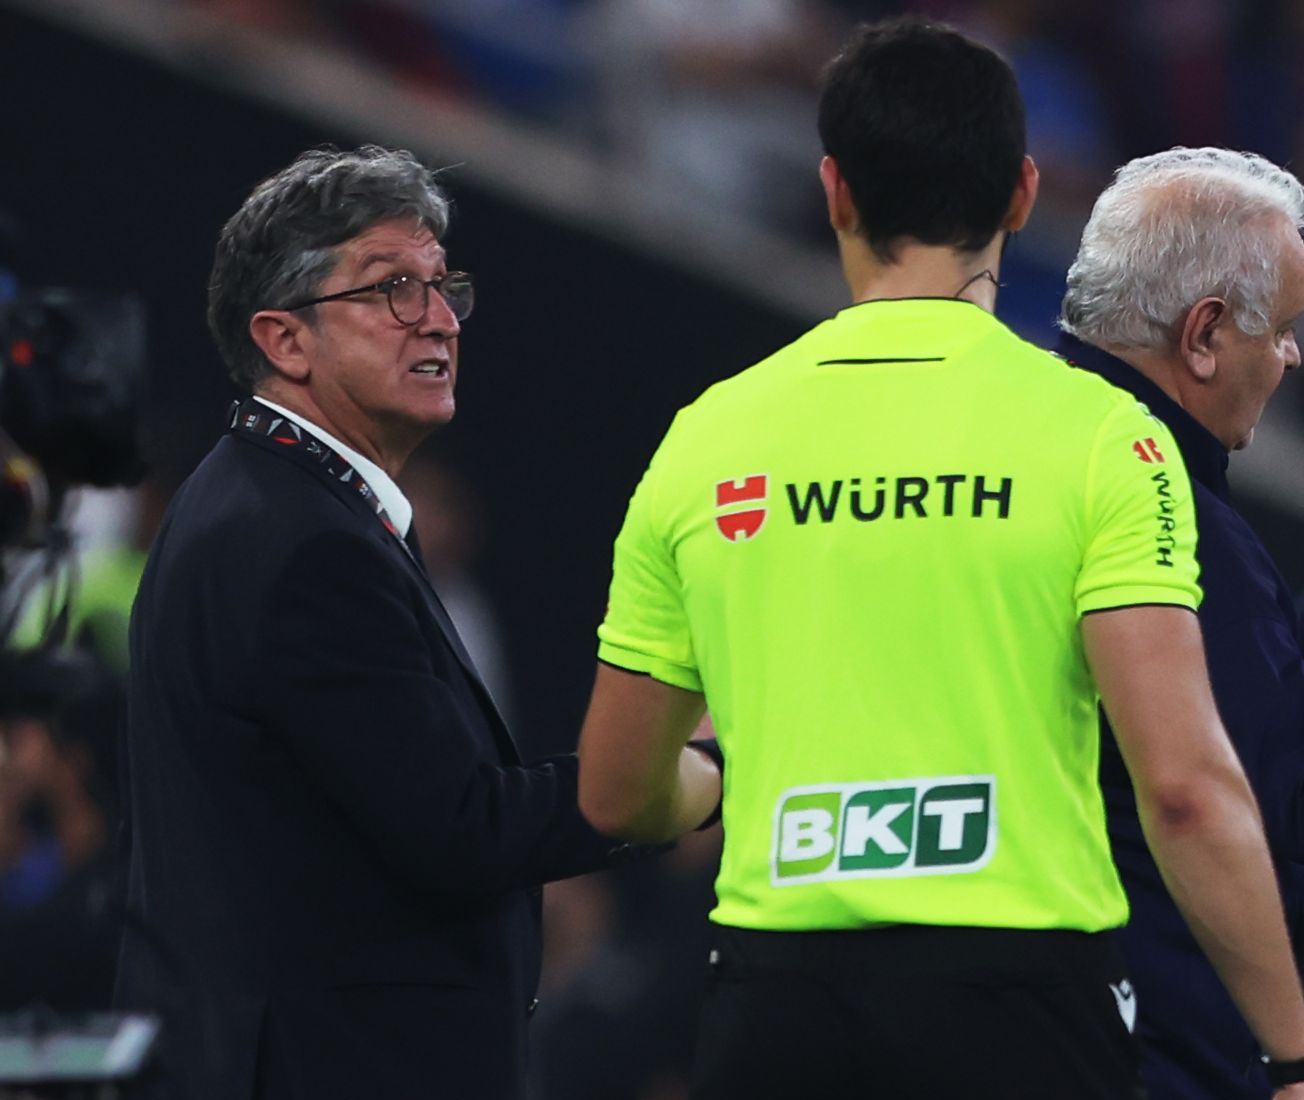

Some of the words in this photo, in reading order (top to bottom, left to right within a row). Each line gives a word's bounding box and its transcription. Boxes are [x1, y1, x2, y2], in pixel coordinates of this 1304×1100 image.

[785, 474, 1012, 525] WÜRTH
[1151, 471, 1176, 568] WÜRTH
[779, 798, 985, 863] BKT
